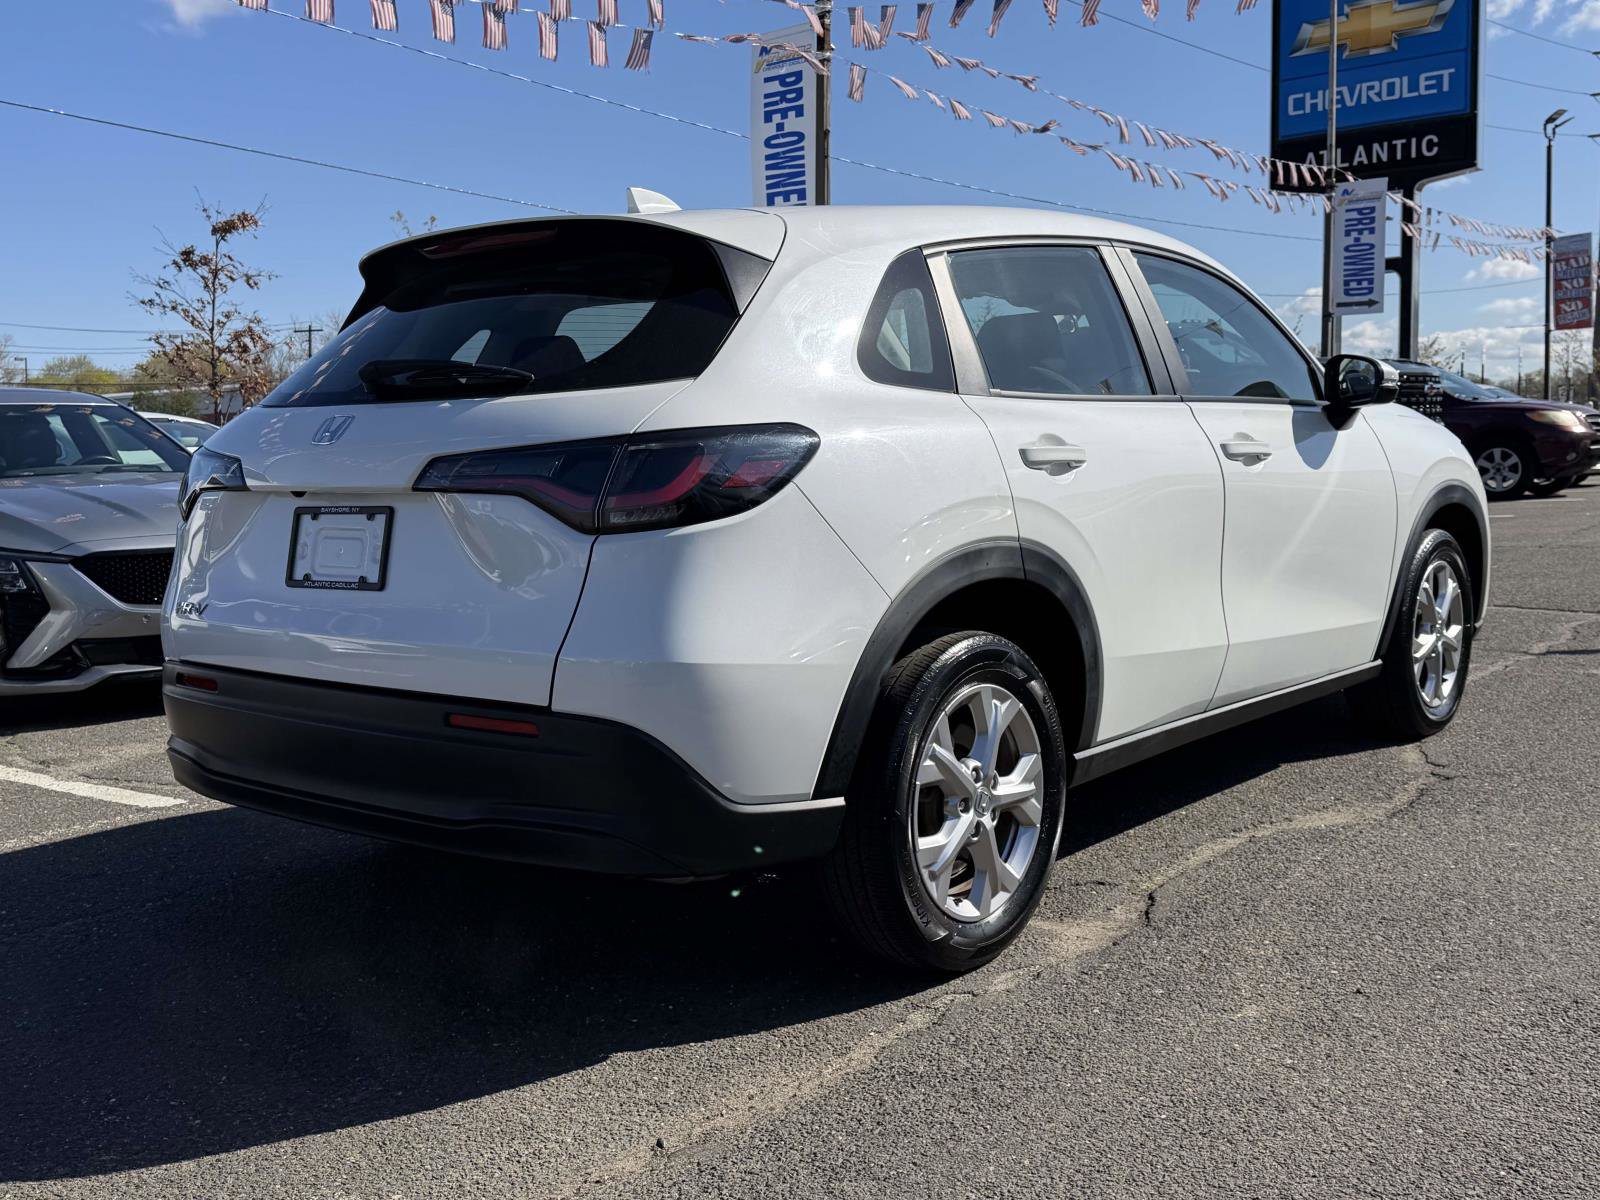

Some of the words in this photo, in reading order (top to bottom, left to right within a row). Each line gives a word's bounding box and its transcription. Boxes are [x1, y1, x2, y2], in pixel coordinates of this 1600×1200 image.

[1287, 68, 1455, 116] CHEVROLET
[763, 69, 807, 206] PRE-OWNE
[1305, 134, 1440, 168] ATLANTIC
[1343, 205, 1376, 297] PRE-OWNED
[1556, 256, 1590, 271] BAD
[1561, 278, 1585, 290] NO
[1559, 300, 1584, 313] NO
